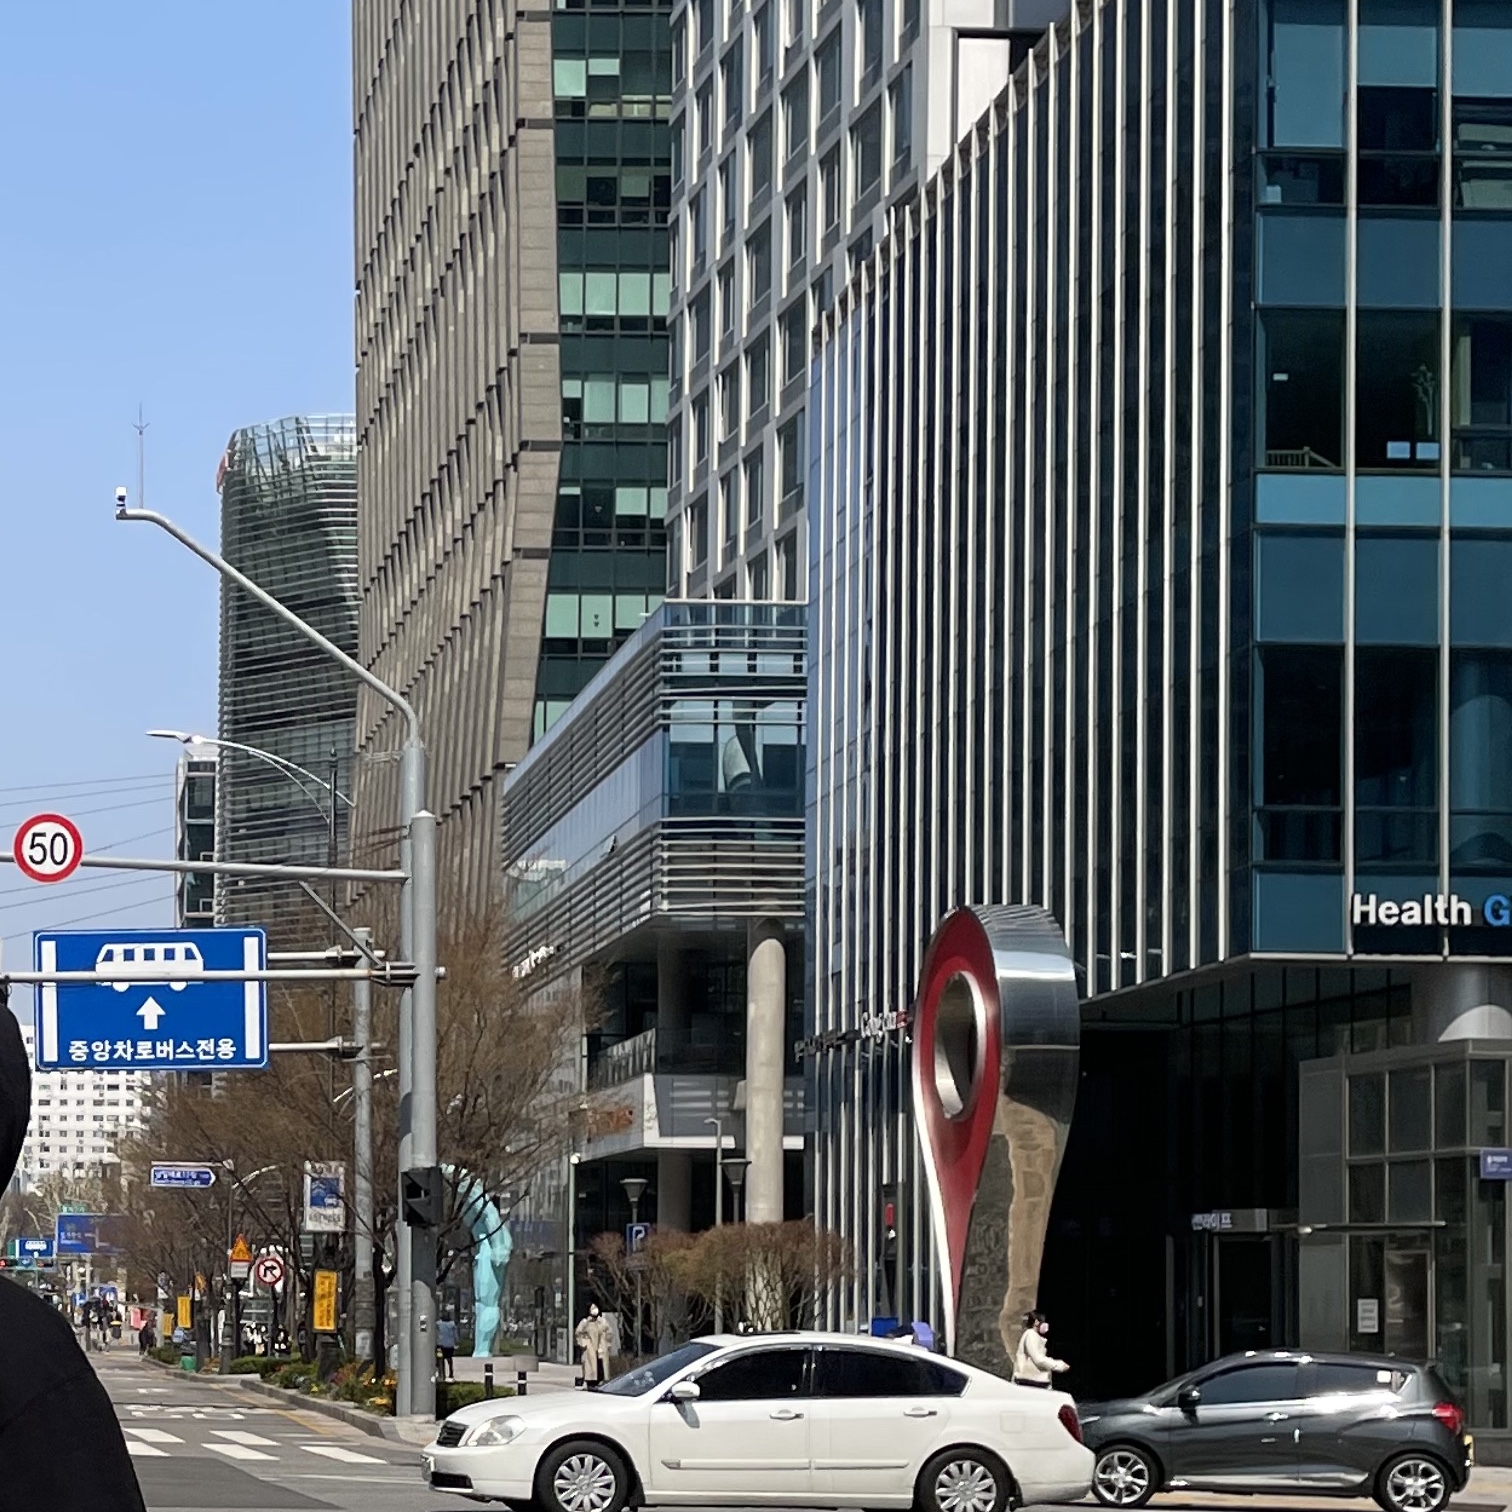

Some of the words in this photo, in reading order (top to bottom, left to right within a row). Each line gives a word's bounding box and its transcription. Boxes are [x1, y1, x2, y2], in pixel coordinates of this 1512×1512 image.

[28, 832, 68, 866] 50
[1353, 893, 1471, 925] Health
[1484, 894, 1512, 926] G
[69, 1041, 236, 1062] 중앙차로버스전용
